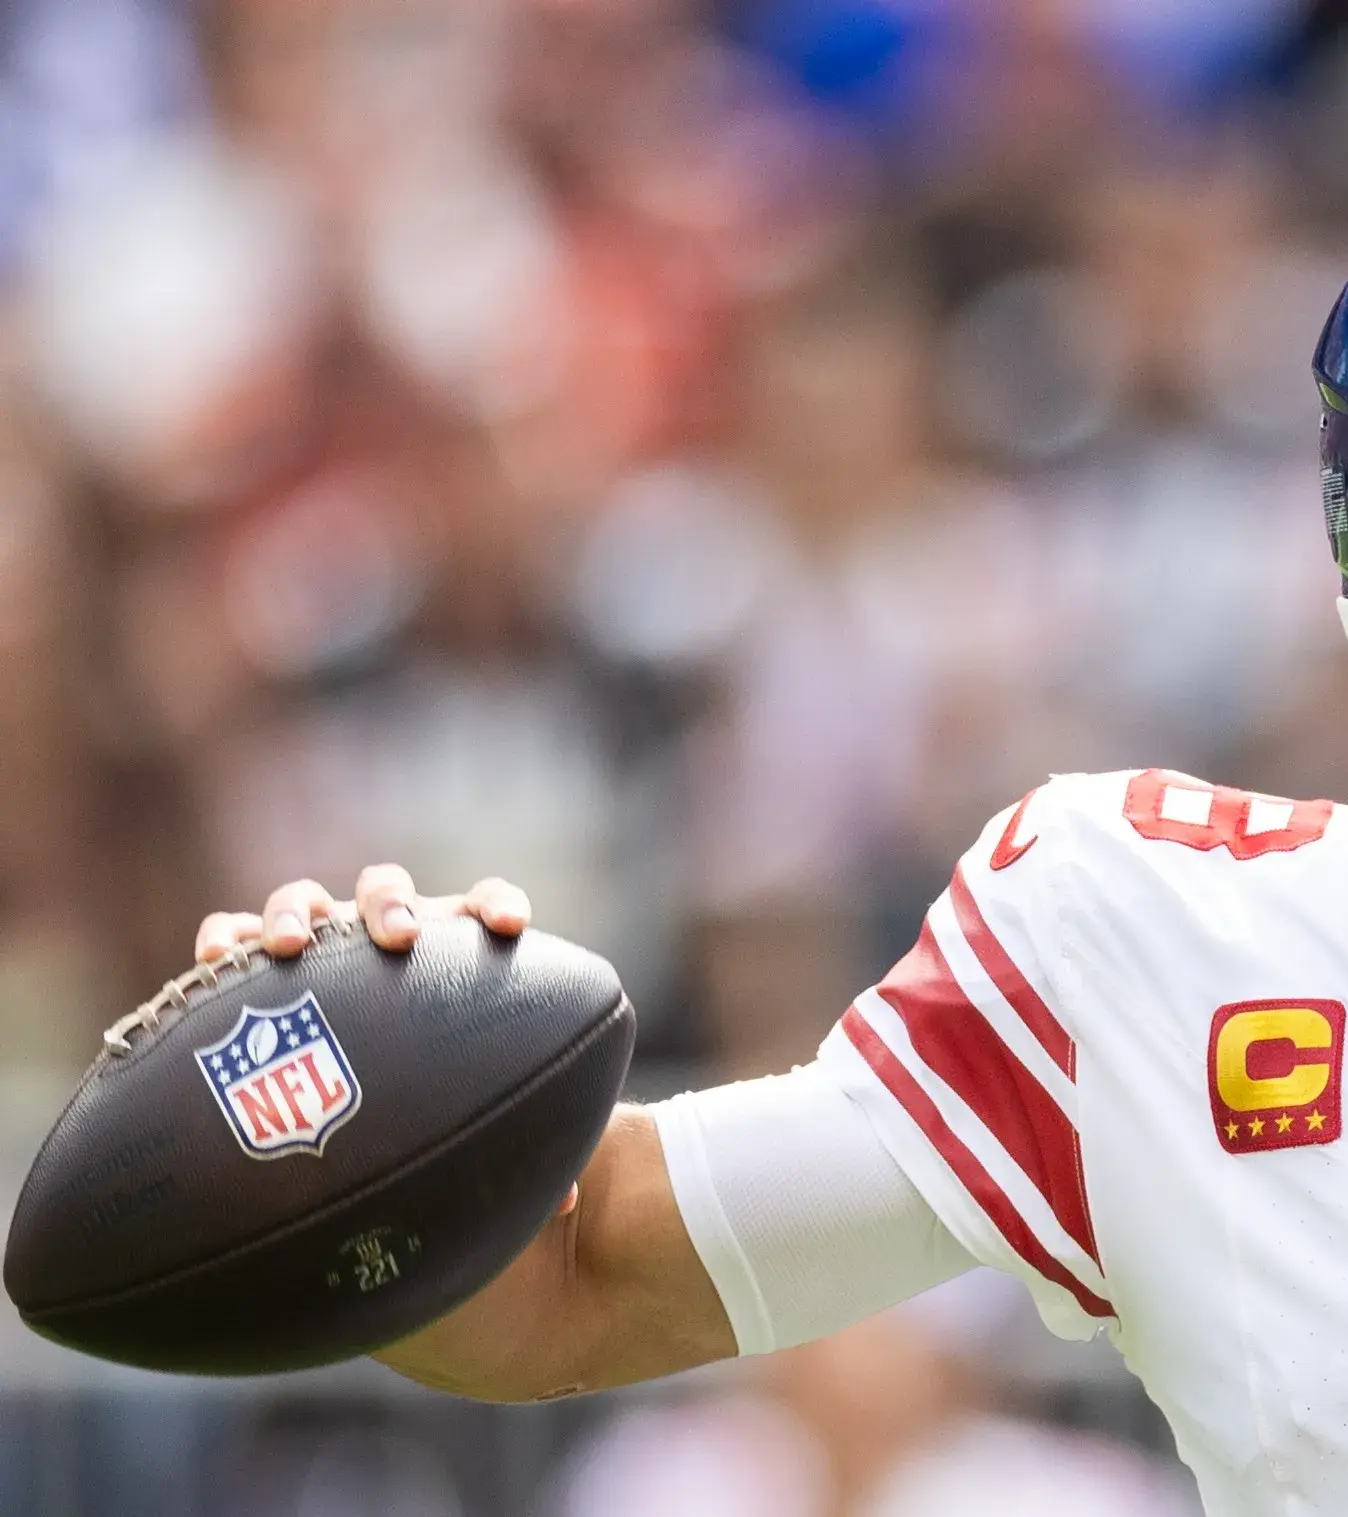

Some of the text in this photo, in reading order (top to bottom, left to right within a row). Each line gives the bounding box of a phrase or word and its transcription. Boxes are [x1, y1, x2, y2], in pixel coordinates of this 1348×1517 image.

[1122, 767, 1334, 860] 8
[232, 1051, 346, 1142] NFL
[1216, 1007, 1332, 1112] C
